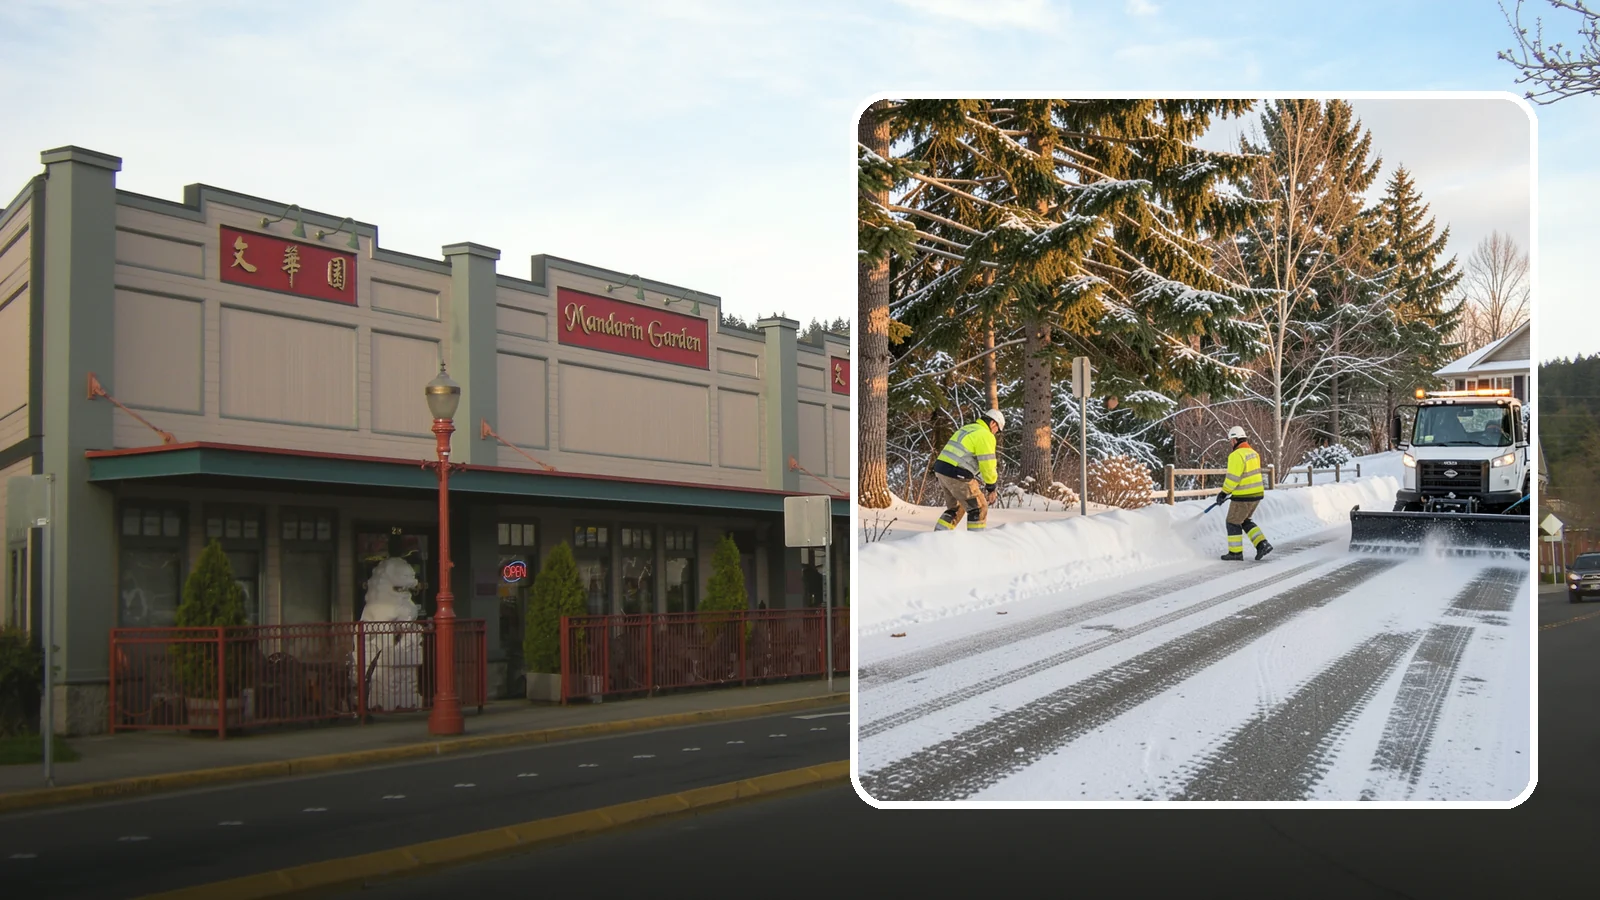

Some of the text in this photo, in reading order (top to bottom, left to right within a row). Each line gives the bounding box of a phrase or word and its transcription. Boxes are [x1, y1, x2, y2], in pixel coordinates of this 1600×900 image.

[231, 236, 346, 291] 文華園
[564, 302, 702, 352] Mandarin Garden
[503, 565, 527, 578] OPEN
